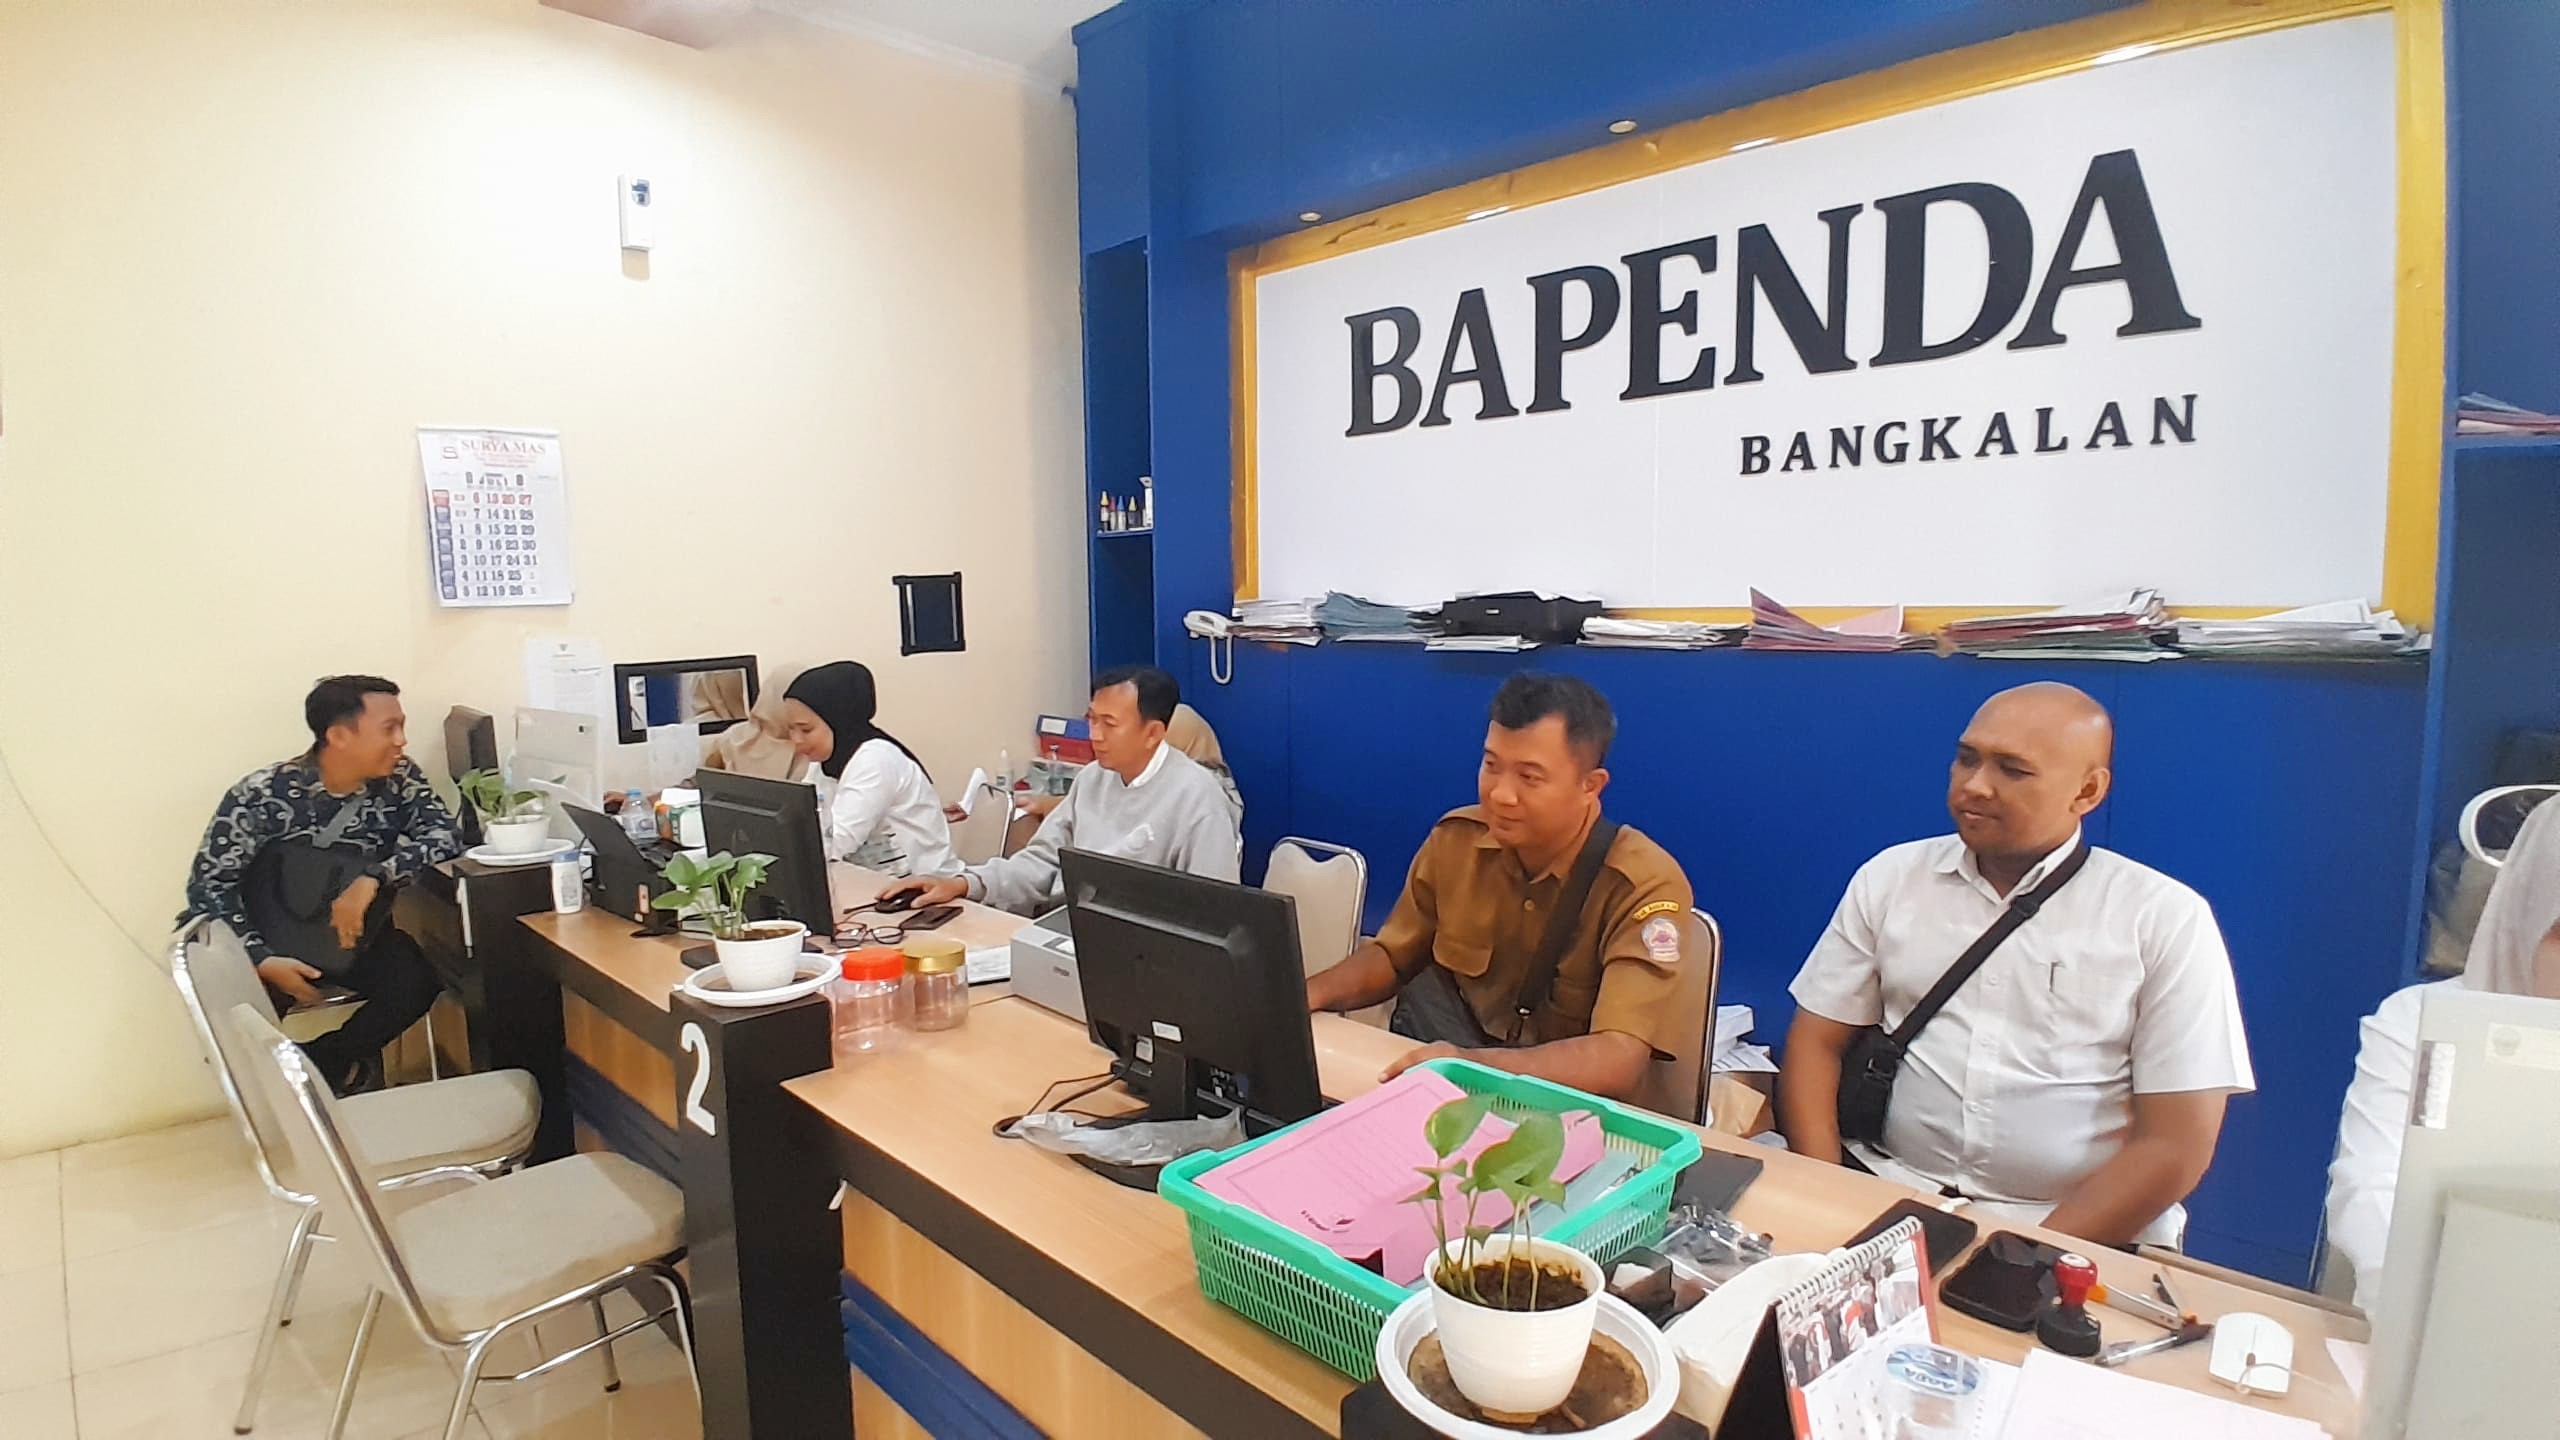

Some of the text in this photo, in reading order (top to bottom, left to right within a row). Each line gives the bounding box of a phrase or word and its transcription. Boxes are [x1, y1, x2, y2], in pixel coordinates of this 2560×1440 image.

[1345, 149, 2202, 438] BAPENDA
[462, 440, 547, 455] SURYA MAS
[1741, 395, 2197, 474] BANGKALAN
[681, 1022, 716, 1136] 2
